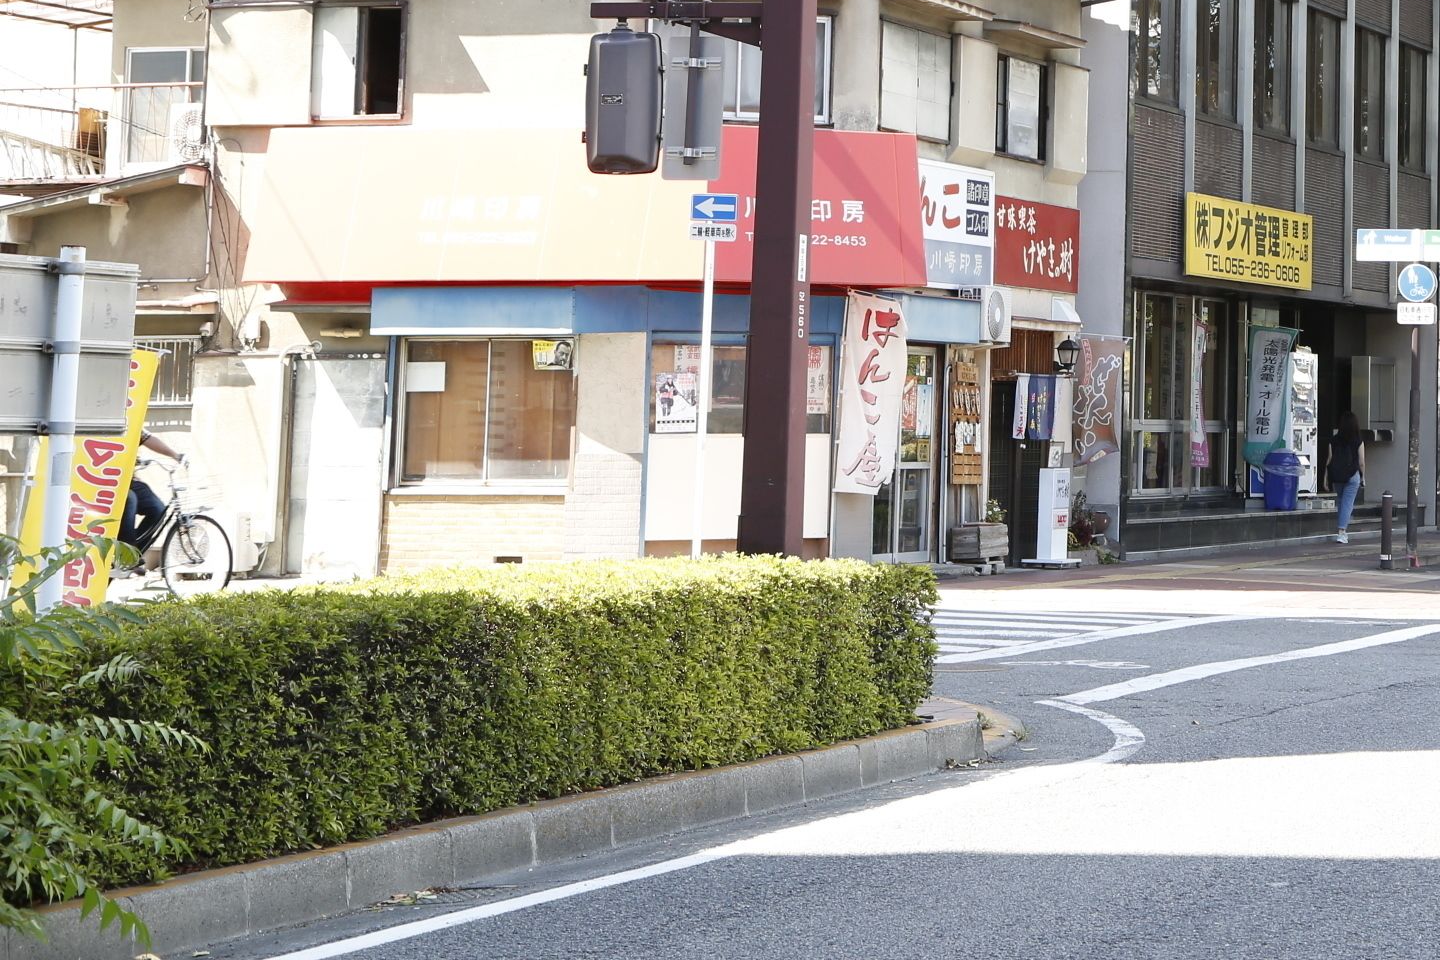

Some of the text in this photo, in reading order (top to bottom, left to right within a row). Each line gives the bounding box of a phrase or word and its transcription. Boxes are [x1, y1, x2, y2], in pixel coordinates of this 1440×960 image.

[967, 212, 989, 234] ゴム印
[997, 203, 1036, 235] 甘味喫茶
[1023, 237, 1074, 283] けやきの樹
[1255, 339, 1280, 436] 太陽光発電・オール電化
